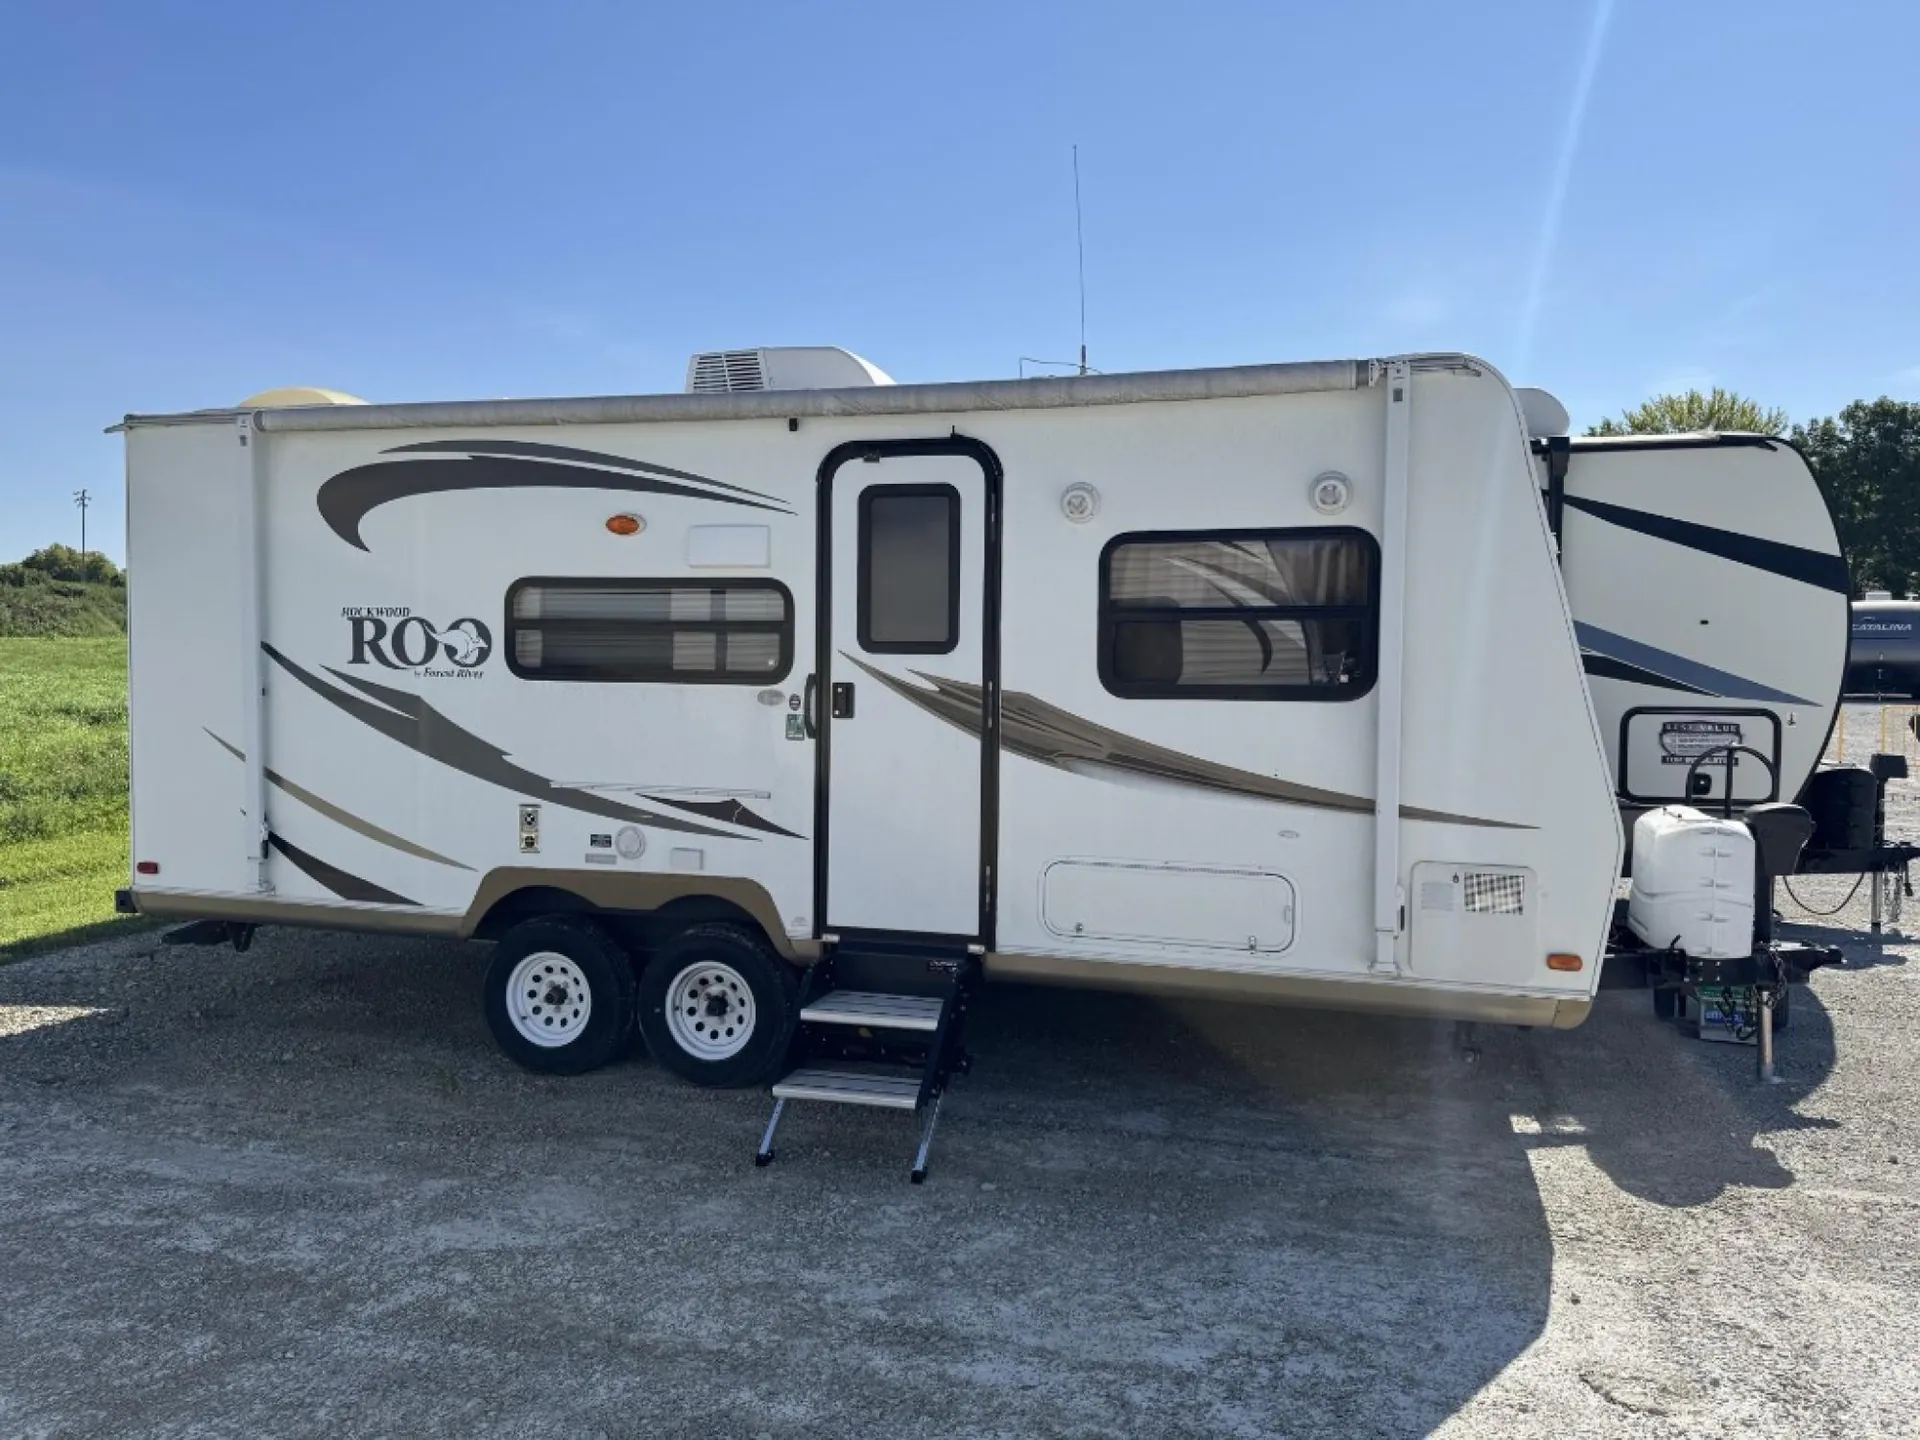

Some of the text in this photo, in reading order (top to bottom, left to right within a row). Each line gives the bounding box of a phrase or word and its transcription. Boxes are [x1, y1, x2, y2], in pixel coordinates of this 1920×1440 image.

[341, 606, 410, 618] ROCKWOOD
[1852, 623, 1913, 631] CATALINA
[347, 616, 492, 670] ROO
[423, 666, 455, 678] Forest
[456, 668, 484, 680] River
